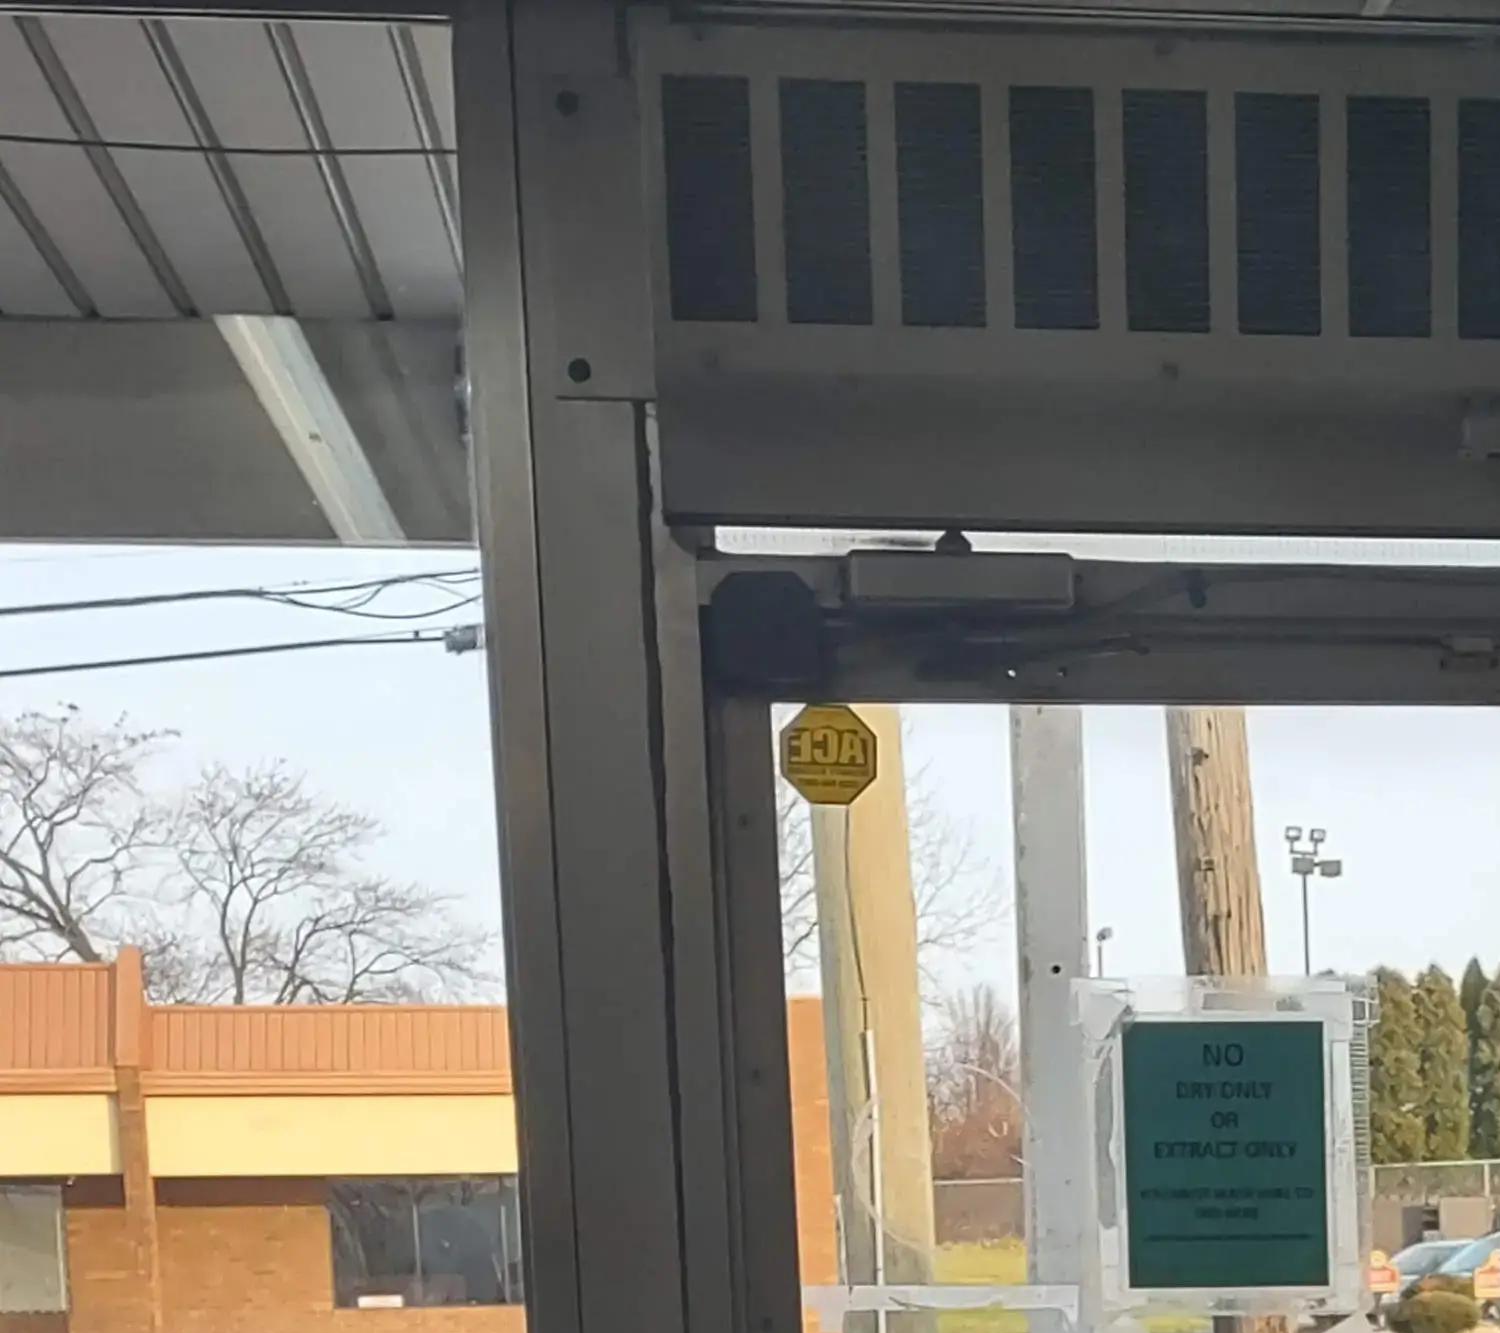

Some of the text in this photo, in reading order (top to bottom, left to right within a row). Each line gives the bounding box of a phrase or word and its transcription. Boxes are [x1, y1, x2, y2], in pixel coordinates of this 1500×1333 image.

[1203, 1043, 1244, 1067] NO
[1210, 1111, 1239, 1129] OR
[1154, 1140, 1298, 1160] EXTRACT ONLY
